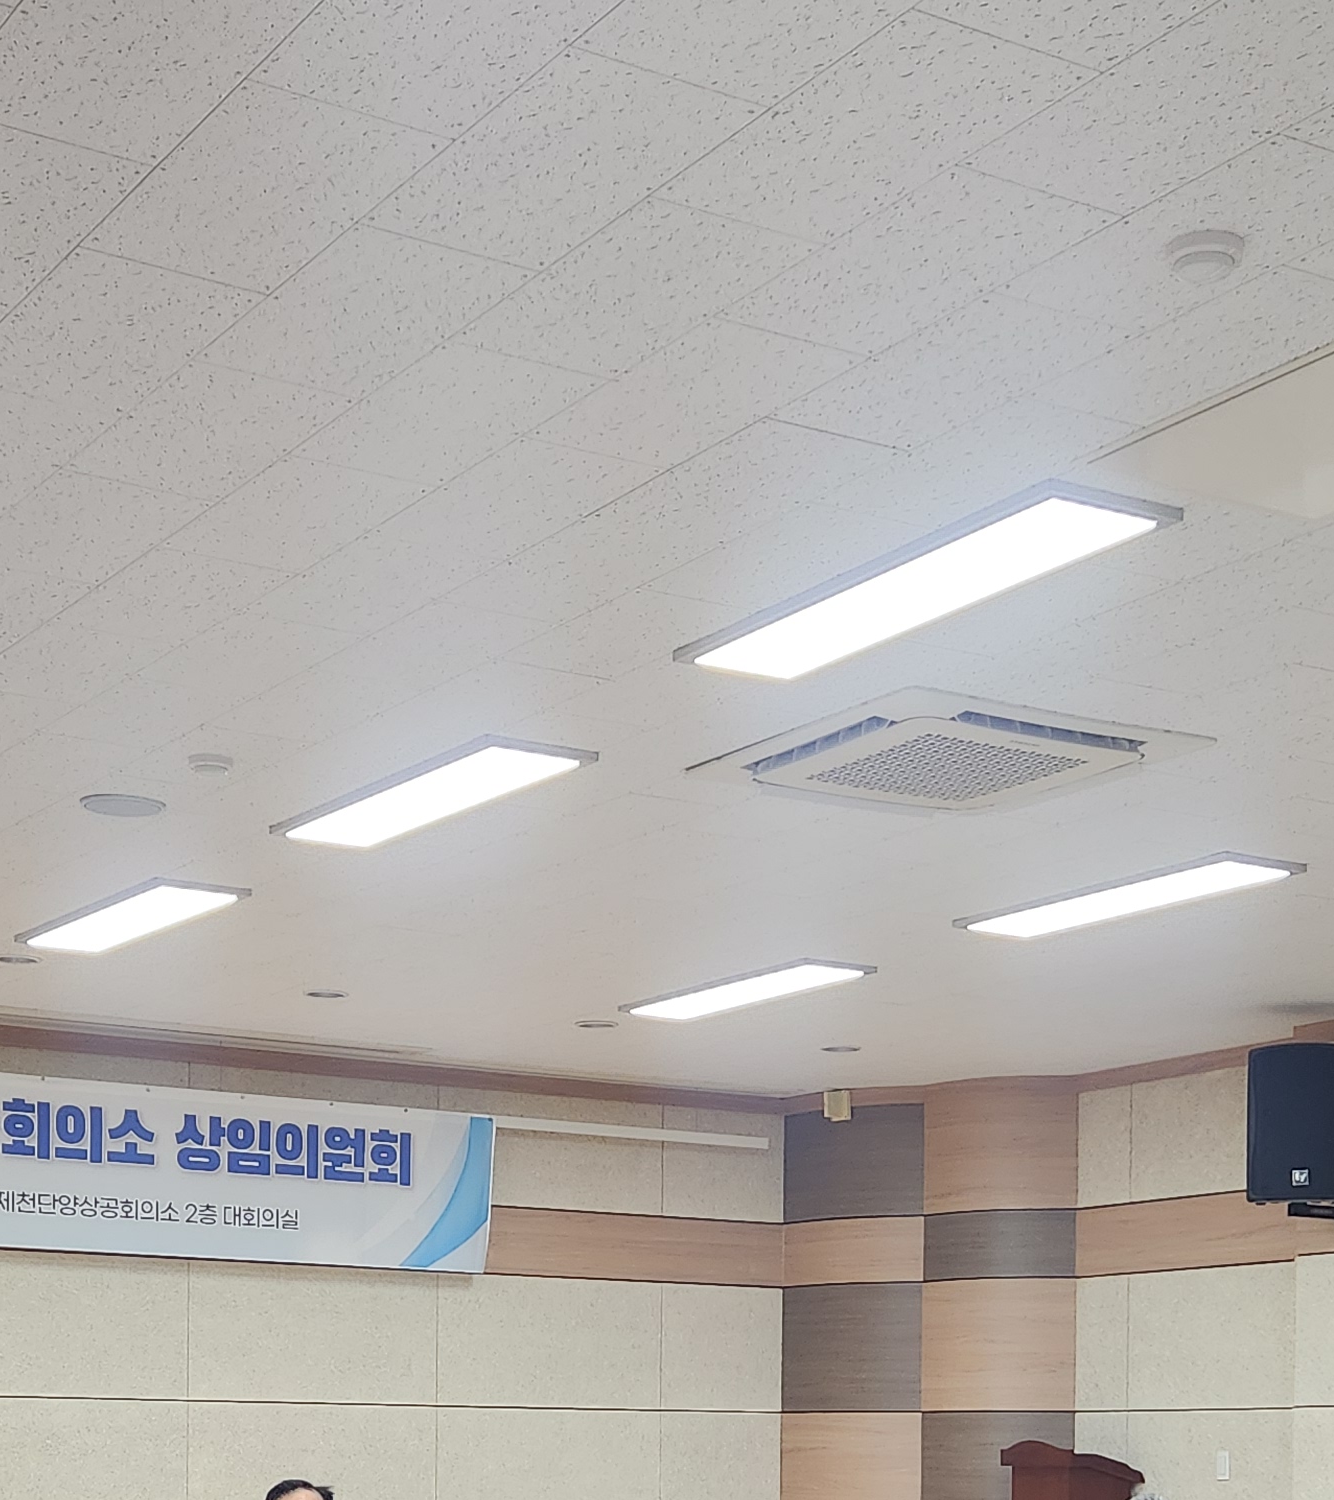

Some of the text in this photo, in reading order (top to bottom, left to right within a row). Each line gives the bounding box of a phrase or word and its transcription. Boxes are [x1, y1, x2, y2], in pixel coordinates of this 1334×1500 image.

[175, 1114, 412, 1187] 상임의원회
[185, 1203, 218, 1226] 2층
[223, 1205, 299, 1231] 대회의실
